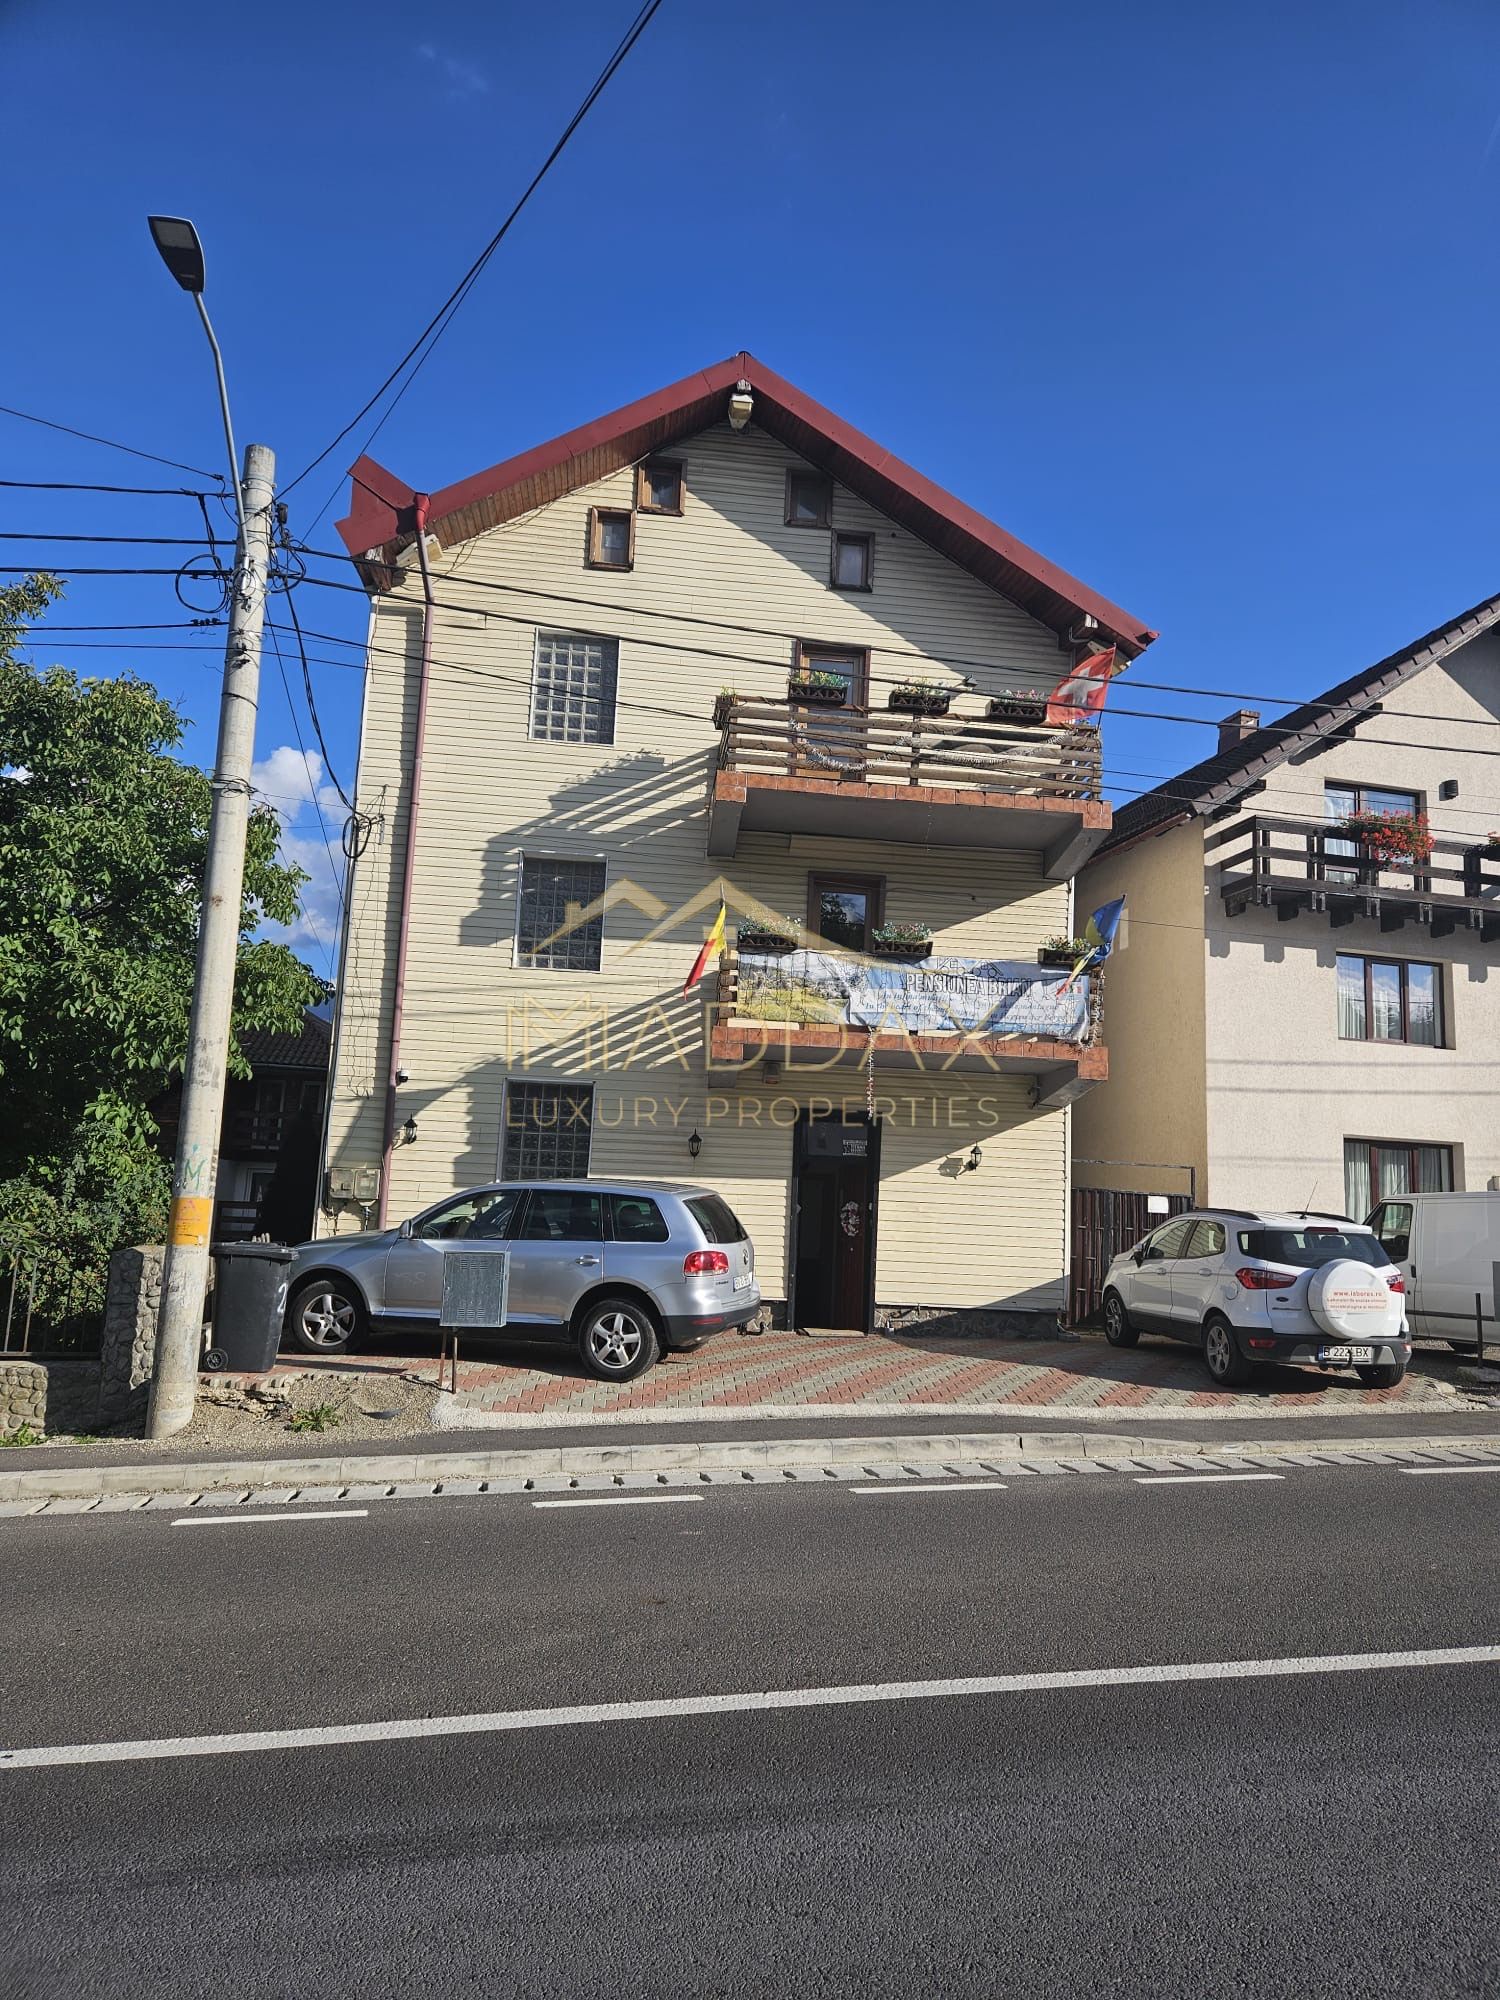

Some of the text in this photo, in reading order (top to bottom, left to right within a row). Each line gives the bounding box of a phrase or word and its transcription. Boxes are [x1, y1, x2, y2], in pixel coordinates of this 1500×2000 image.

[905, 973, 1032, 997] PENSIUNEA BRIAN
[1323, 1346, 1330, 1357] B
